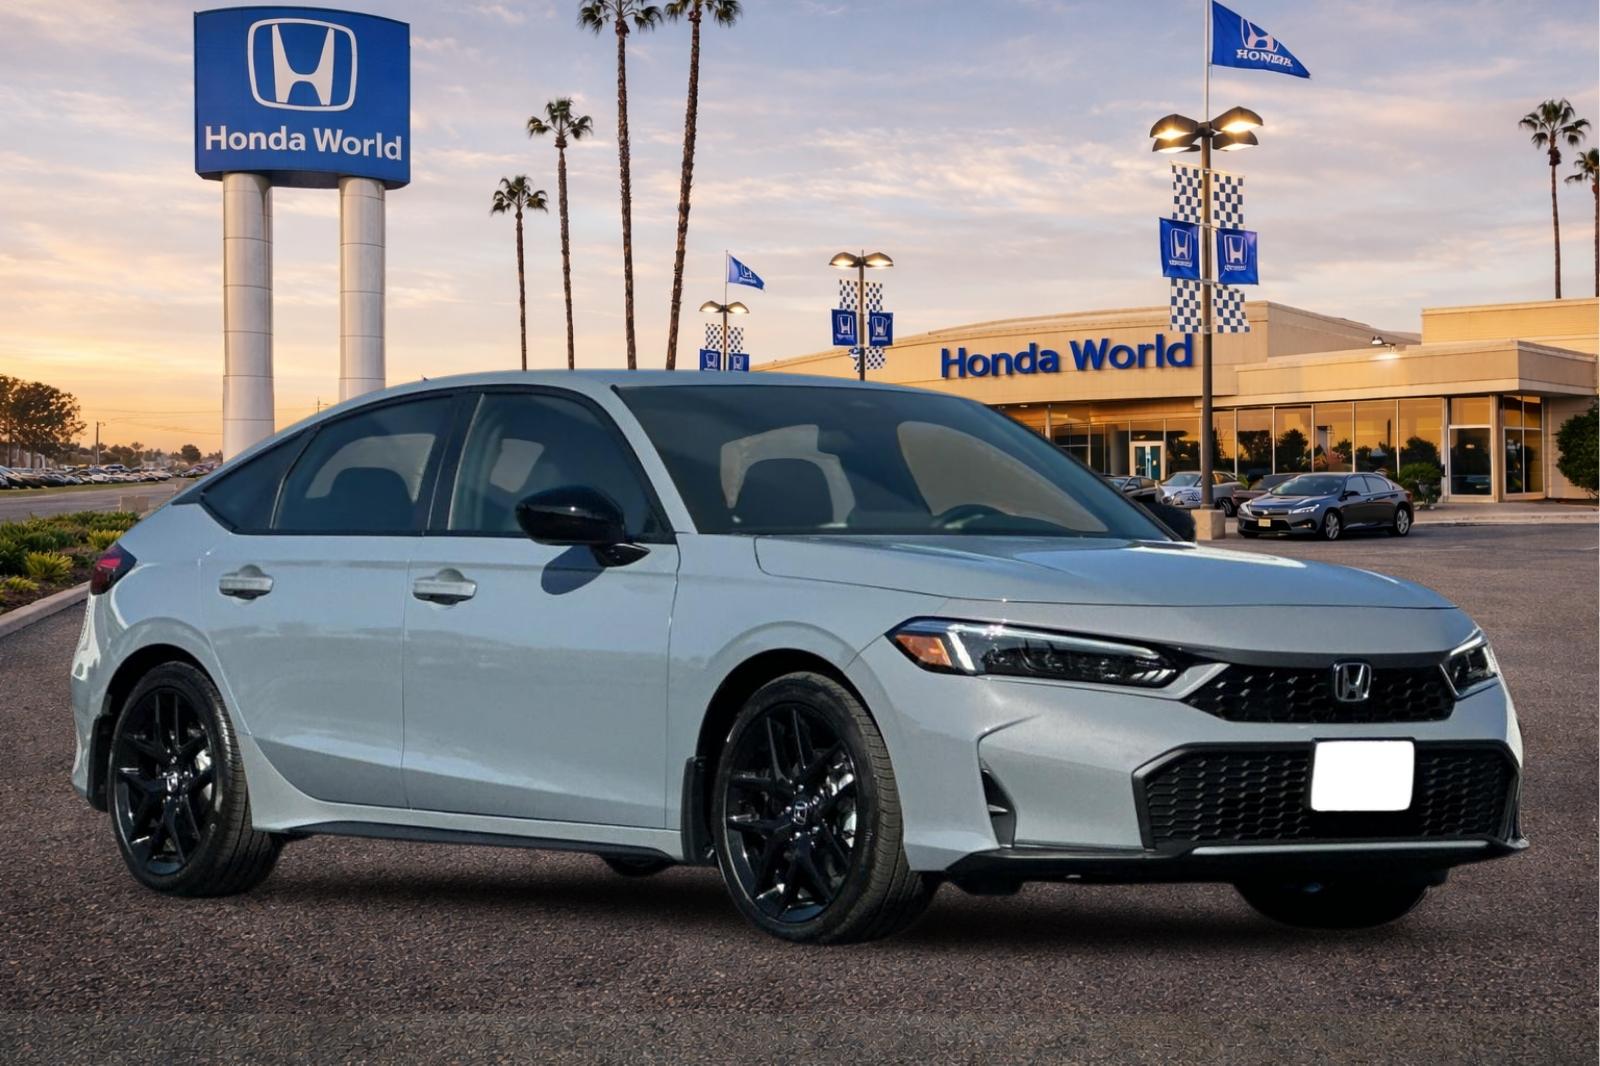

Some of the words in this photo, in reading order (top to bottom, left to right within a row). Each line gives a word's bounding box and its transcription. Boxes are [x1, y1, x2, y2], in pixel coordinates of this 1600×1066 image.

[205, 125, 306, 151] Honda
[313, 127, 402, 161] World
[941, 342, 1061, 379] Honda
[1069, 333, 1194, 372] World
